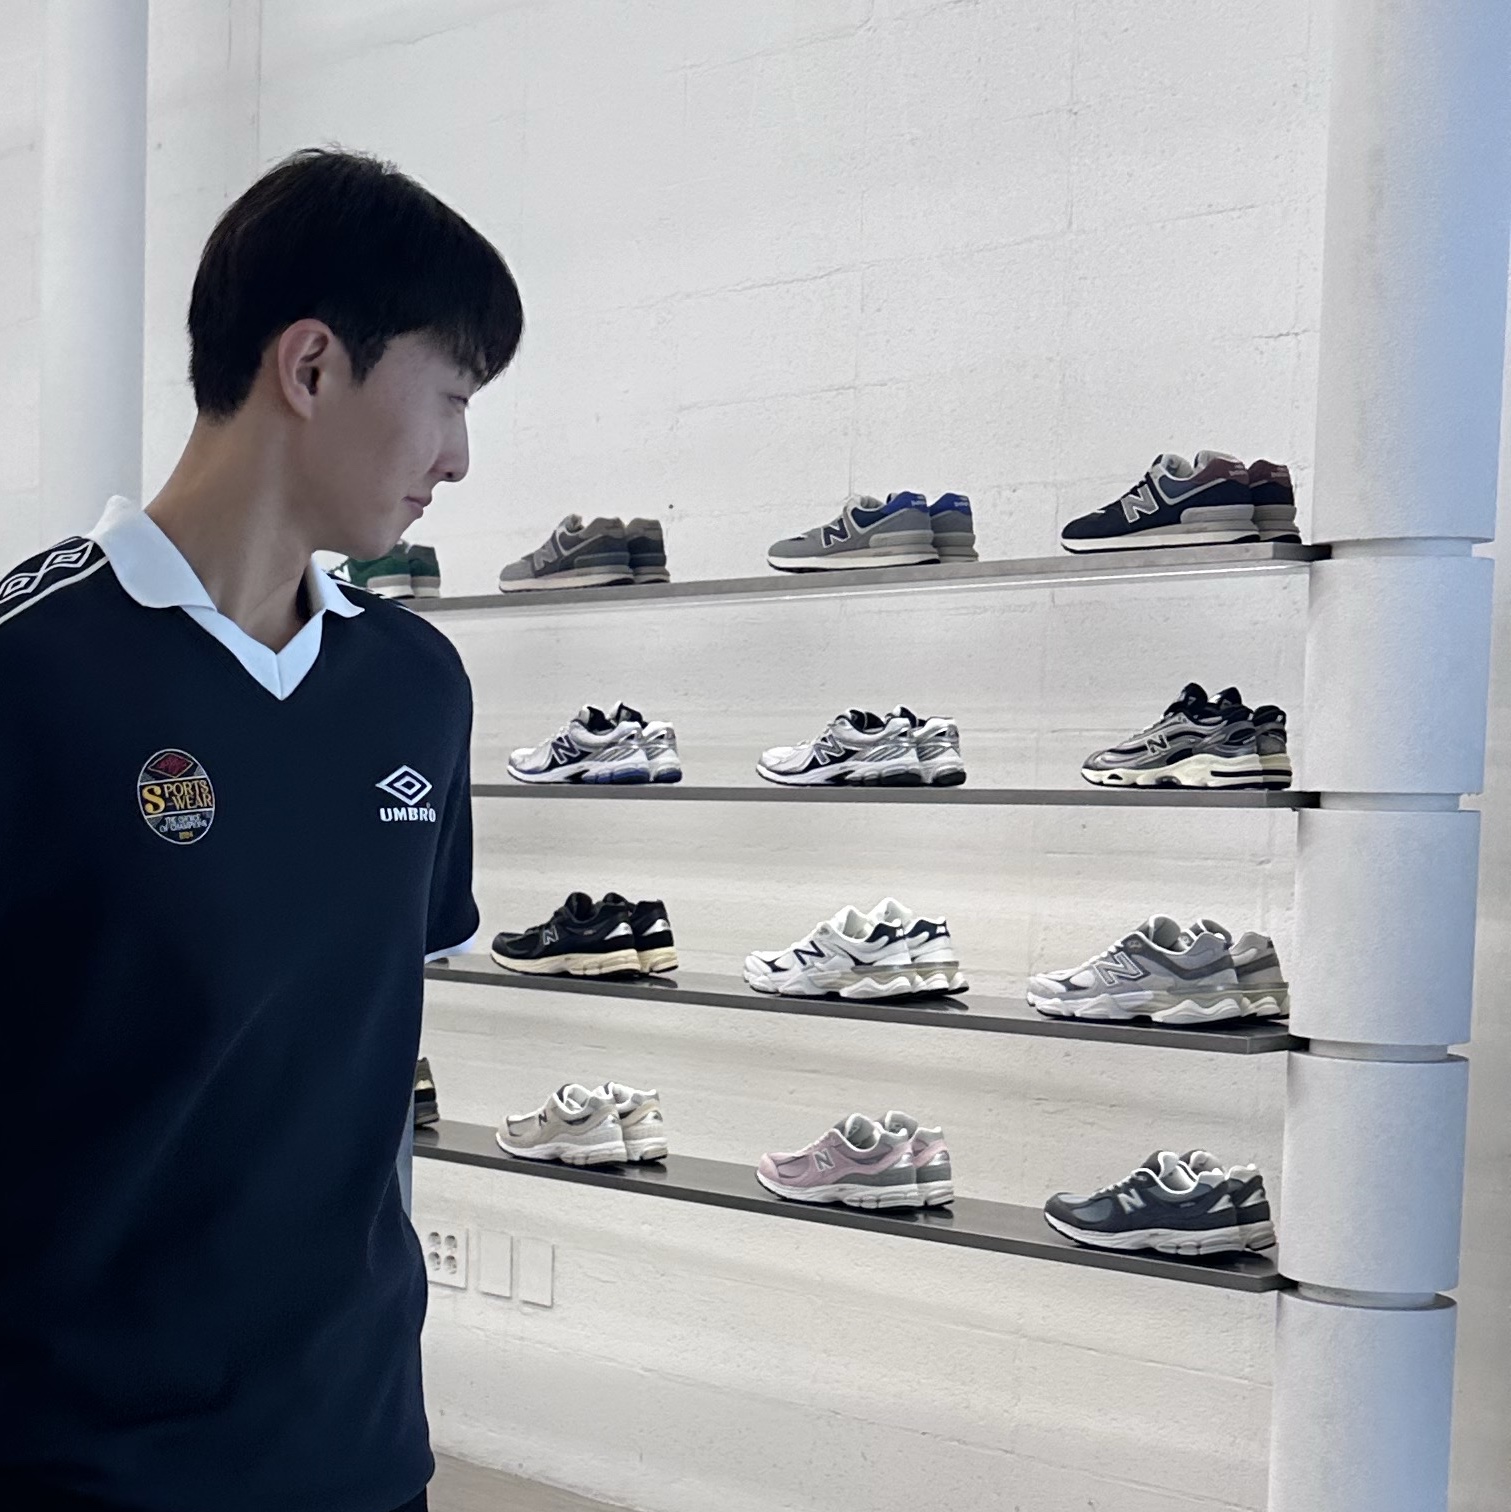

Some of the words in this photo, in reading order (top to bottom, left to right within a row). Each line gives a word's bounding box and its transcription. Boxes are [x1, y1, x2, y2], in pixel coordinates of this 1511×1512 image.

[1120, 483, 1160, 524] N
[821, 517, 851, 548] N
[551, 733, 581, 765] N
[813, 733, 846, 766] N
[1146, 733, 1171, 754] N
[379, 806, 437, 822] UMBRO
[542, 925, 559, 946] N
[793, 940, 826, 966] N
[1093, 951, 1144, 986] N
[813, 1148, 836, 1172] N
[1117, 1188, 1146, 1214] N
